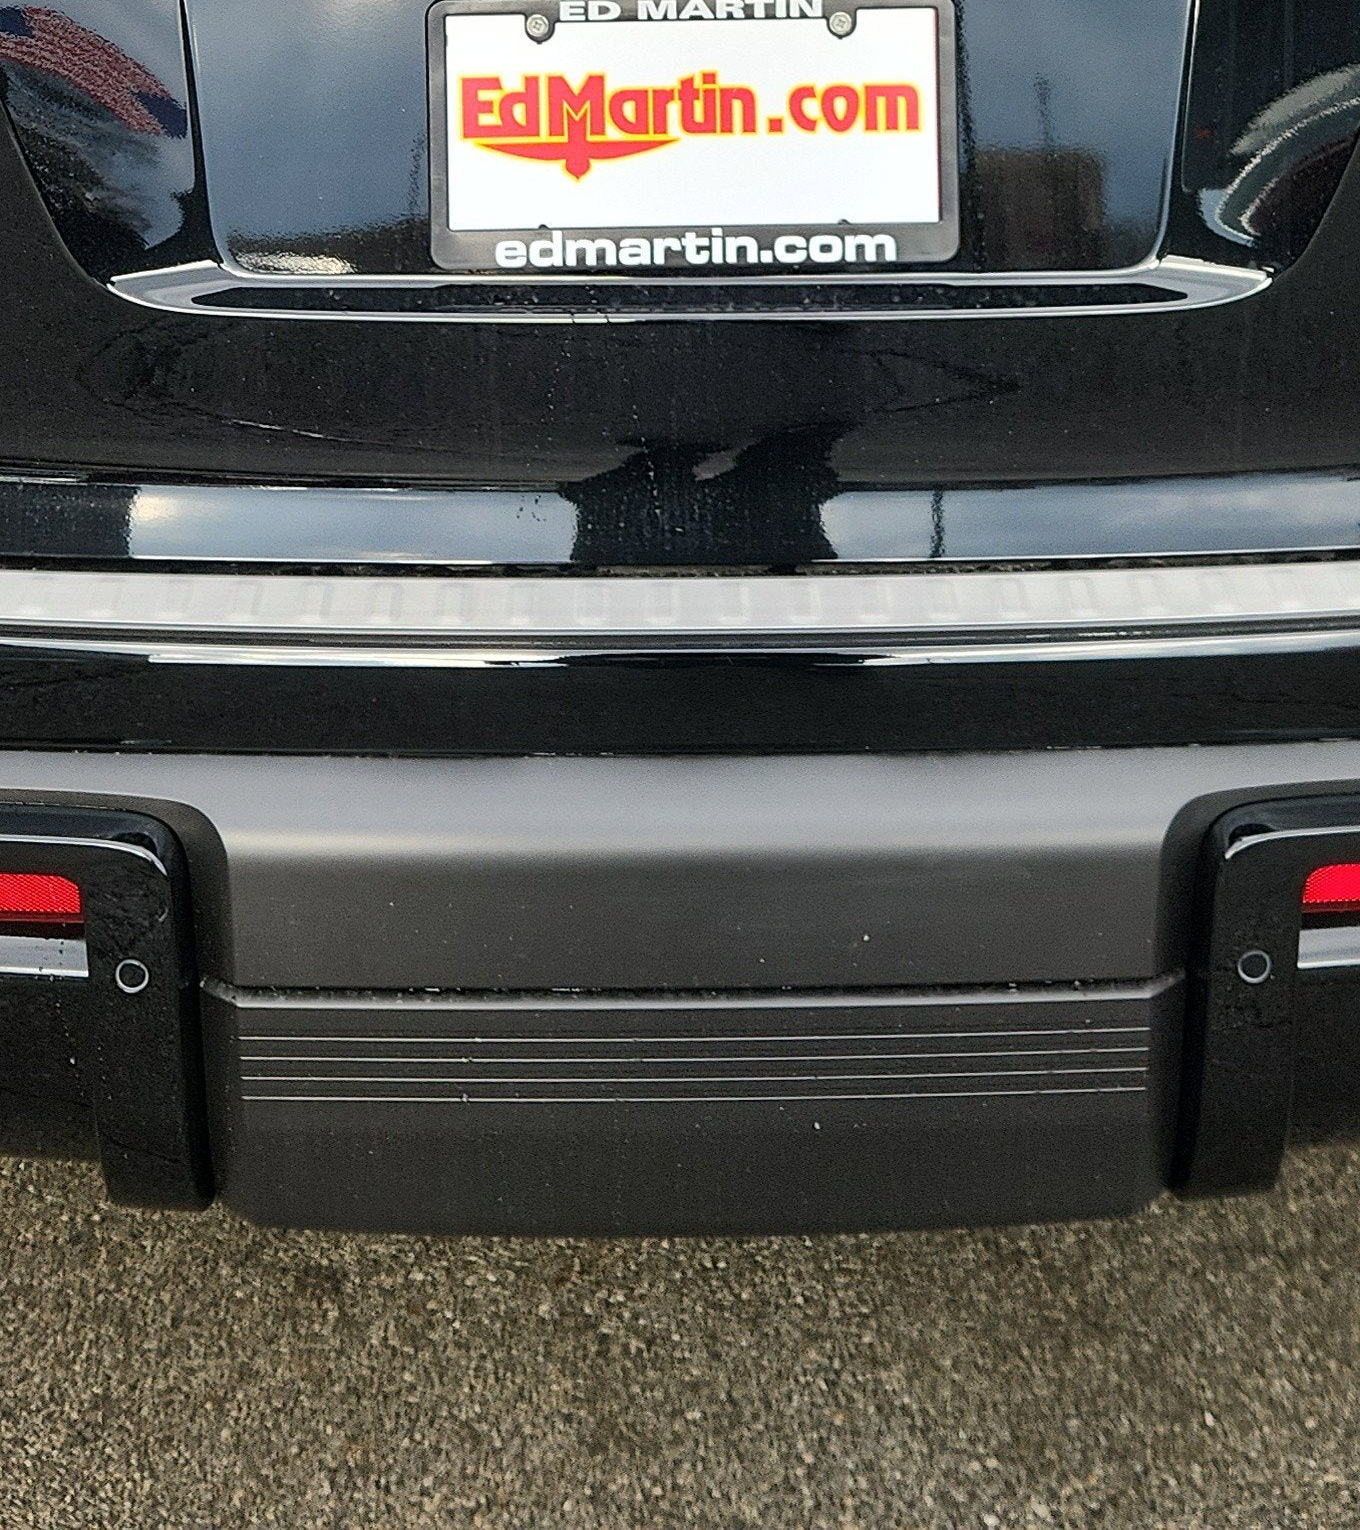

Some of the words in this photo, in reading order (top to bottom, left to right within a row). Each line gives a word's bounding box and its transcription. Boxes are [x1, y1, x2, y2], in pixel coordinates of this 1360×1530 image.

[558, 0, 623, 21] ED
[459, 70, 922, 154] EdMartin.com
[495, 229, 897, 268] edmartin.com
